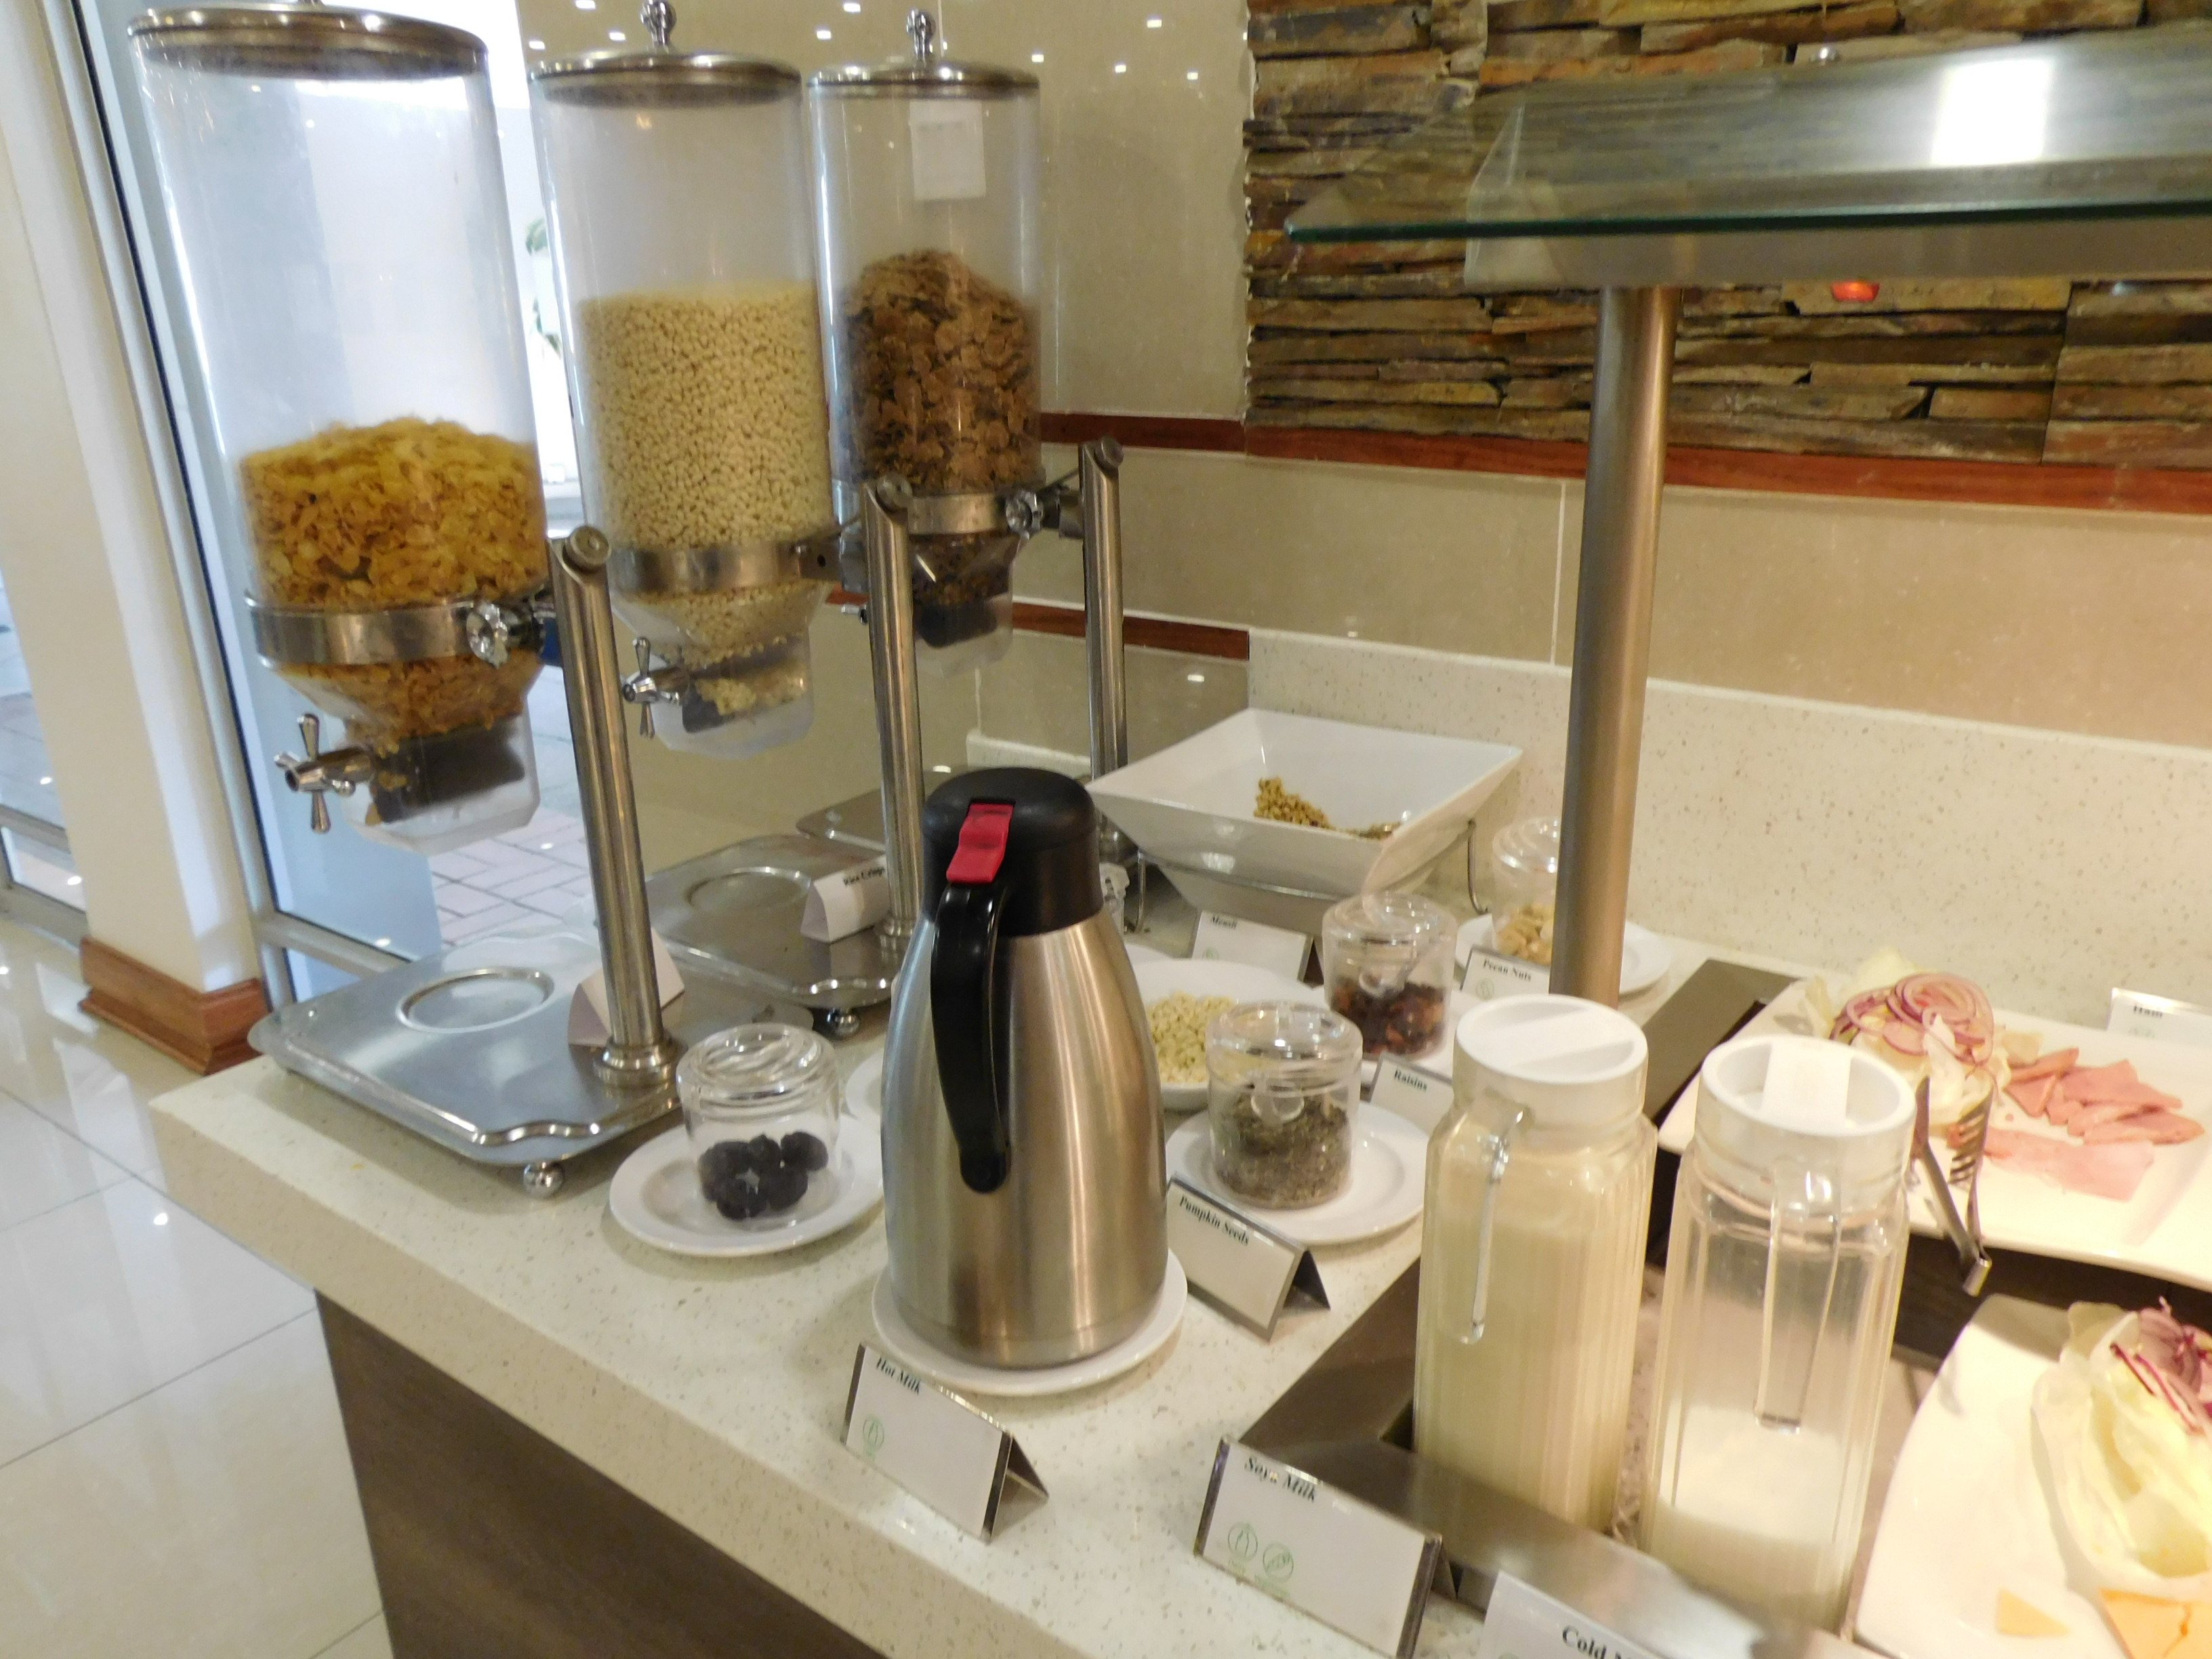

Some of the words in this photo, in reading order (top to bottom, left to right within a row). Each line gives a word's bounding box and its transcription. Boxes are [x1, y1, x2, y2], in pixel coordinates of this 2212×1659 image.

[1482, 958, 1509, 975] Pecan
[1511, 966, 1532, 981] Nuts
[1393, 1069, 1428, 1092] Raisins
[1179, 1195, 1221, 1229] Pumpkin
[1222, 1221, 1249, 1245] Seeds
[876, 1356, 895, 1378] Hot
[897, 1370, 921, 1395] Milk
[1283, 1473, 1315, 1502] Milk
[1562, 1624, 1607, 1659] Cold
